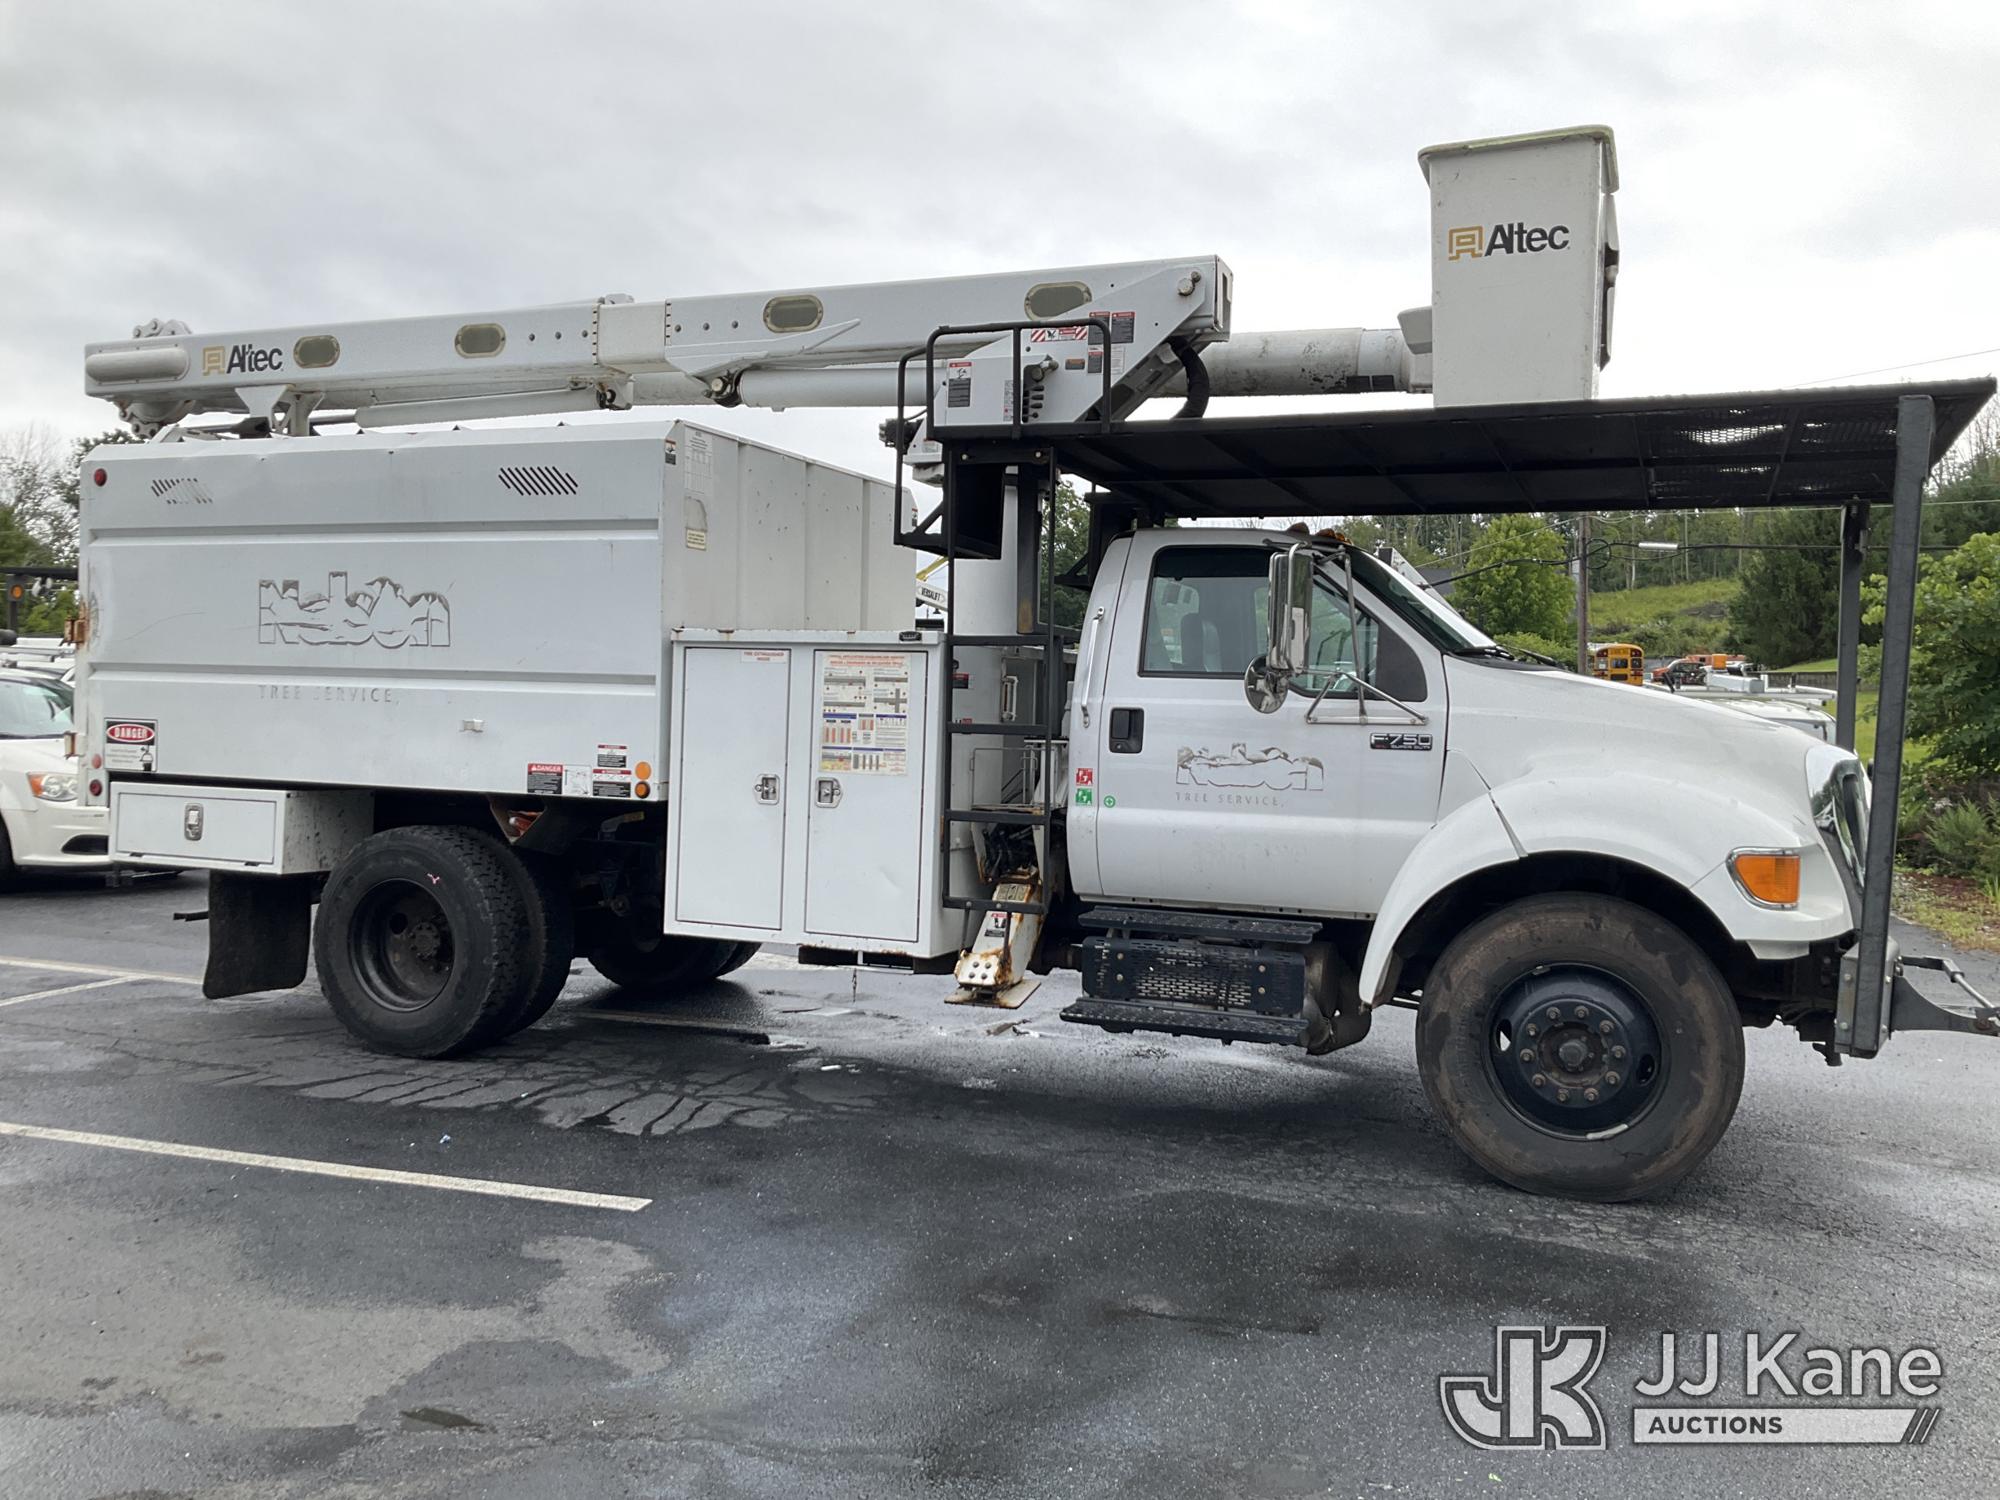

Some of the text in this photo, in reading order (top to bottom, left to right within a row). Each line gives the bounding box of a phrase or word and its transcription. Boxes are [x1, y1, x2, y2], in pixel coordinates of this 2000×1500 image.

[1484, 221, 1570, 257] Altec
[226, 343, 284, 374] Altec
[113, 727, 148, 739] DANGER
[536, 764, 562, 773] DANGER
